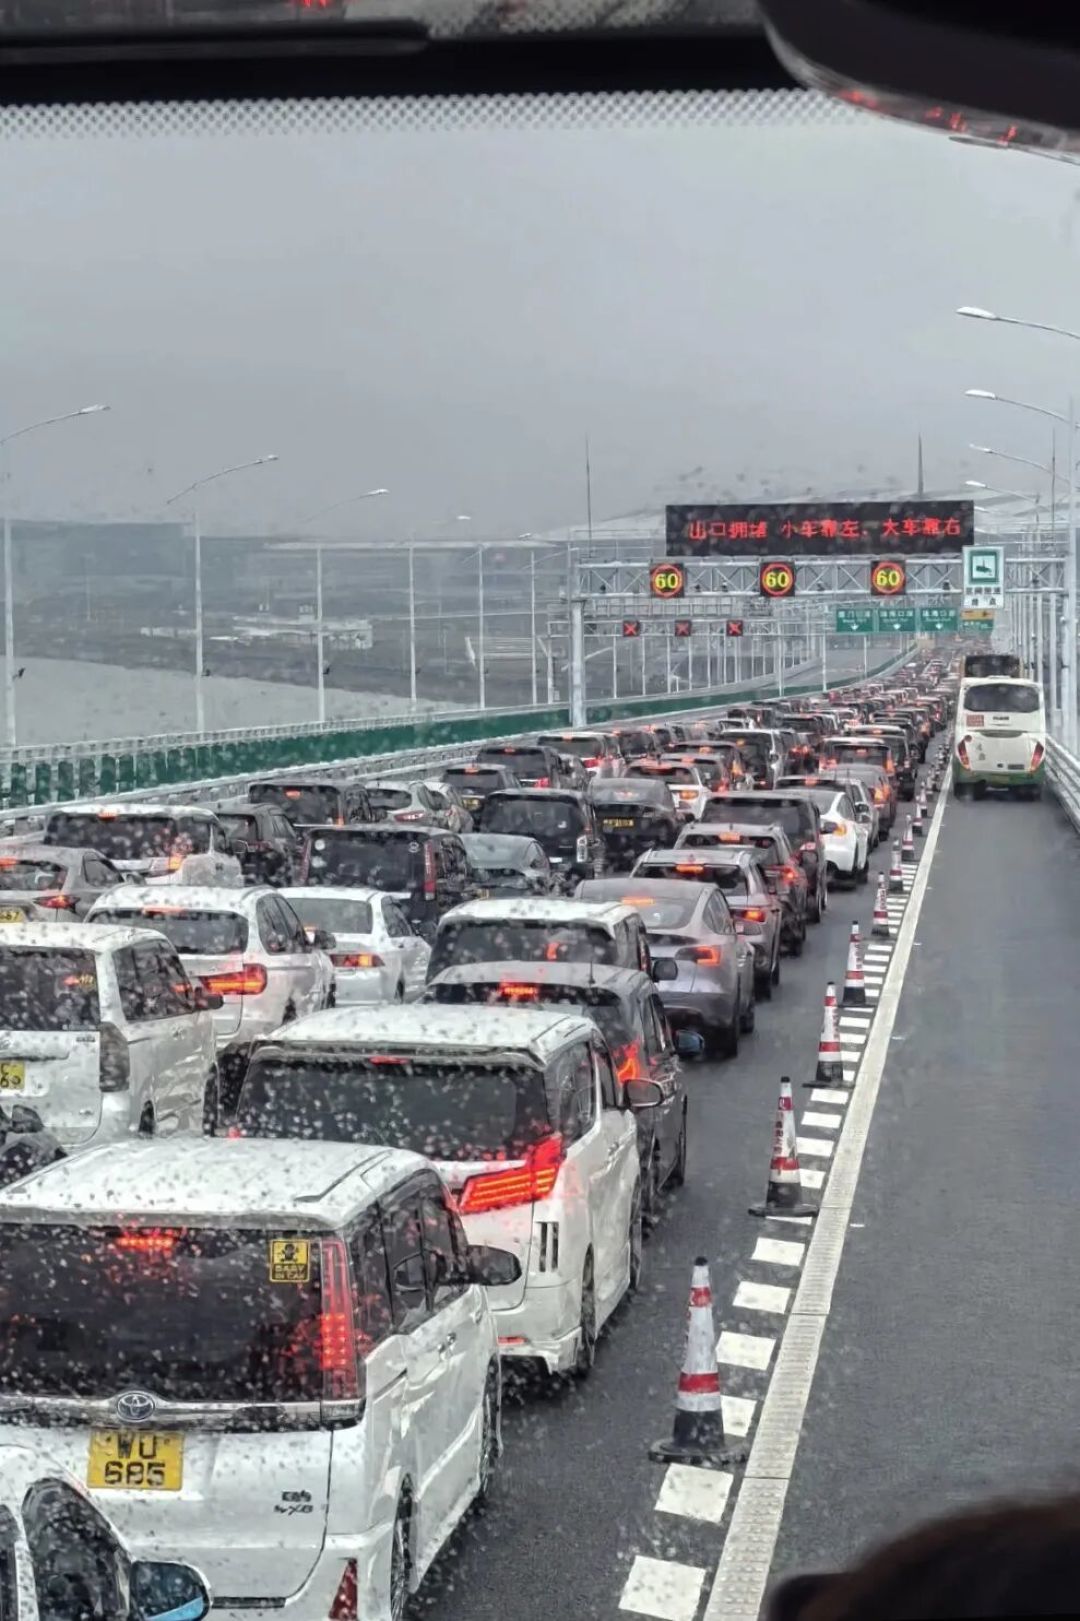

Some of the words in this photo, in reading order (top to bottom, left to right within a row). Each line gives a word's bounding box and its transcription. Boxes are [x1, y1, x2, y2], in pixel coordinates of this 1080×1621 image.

[656, 572, 679, 590] 60
[766, 571, 789, 588] 60
[876, 570, 899, 588] 60
